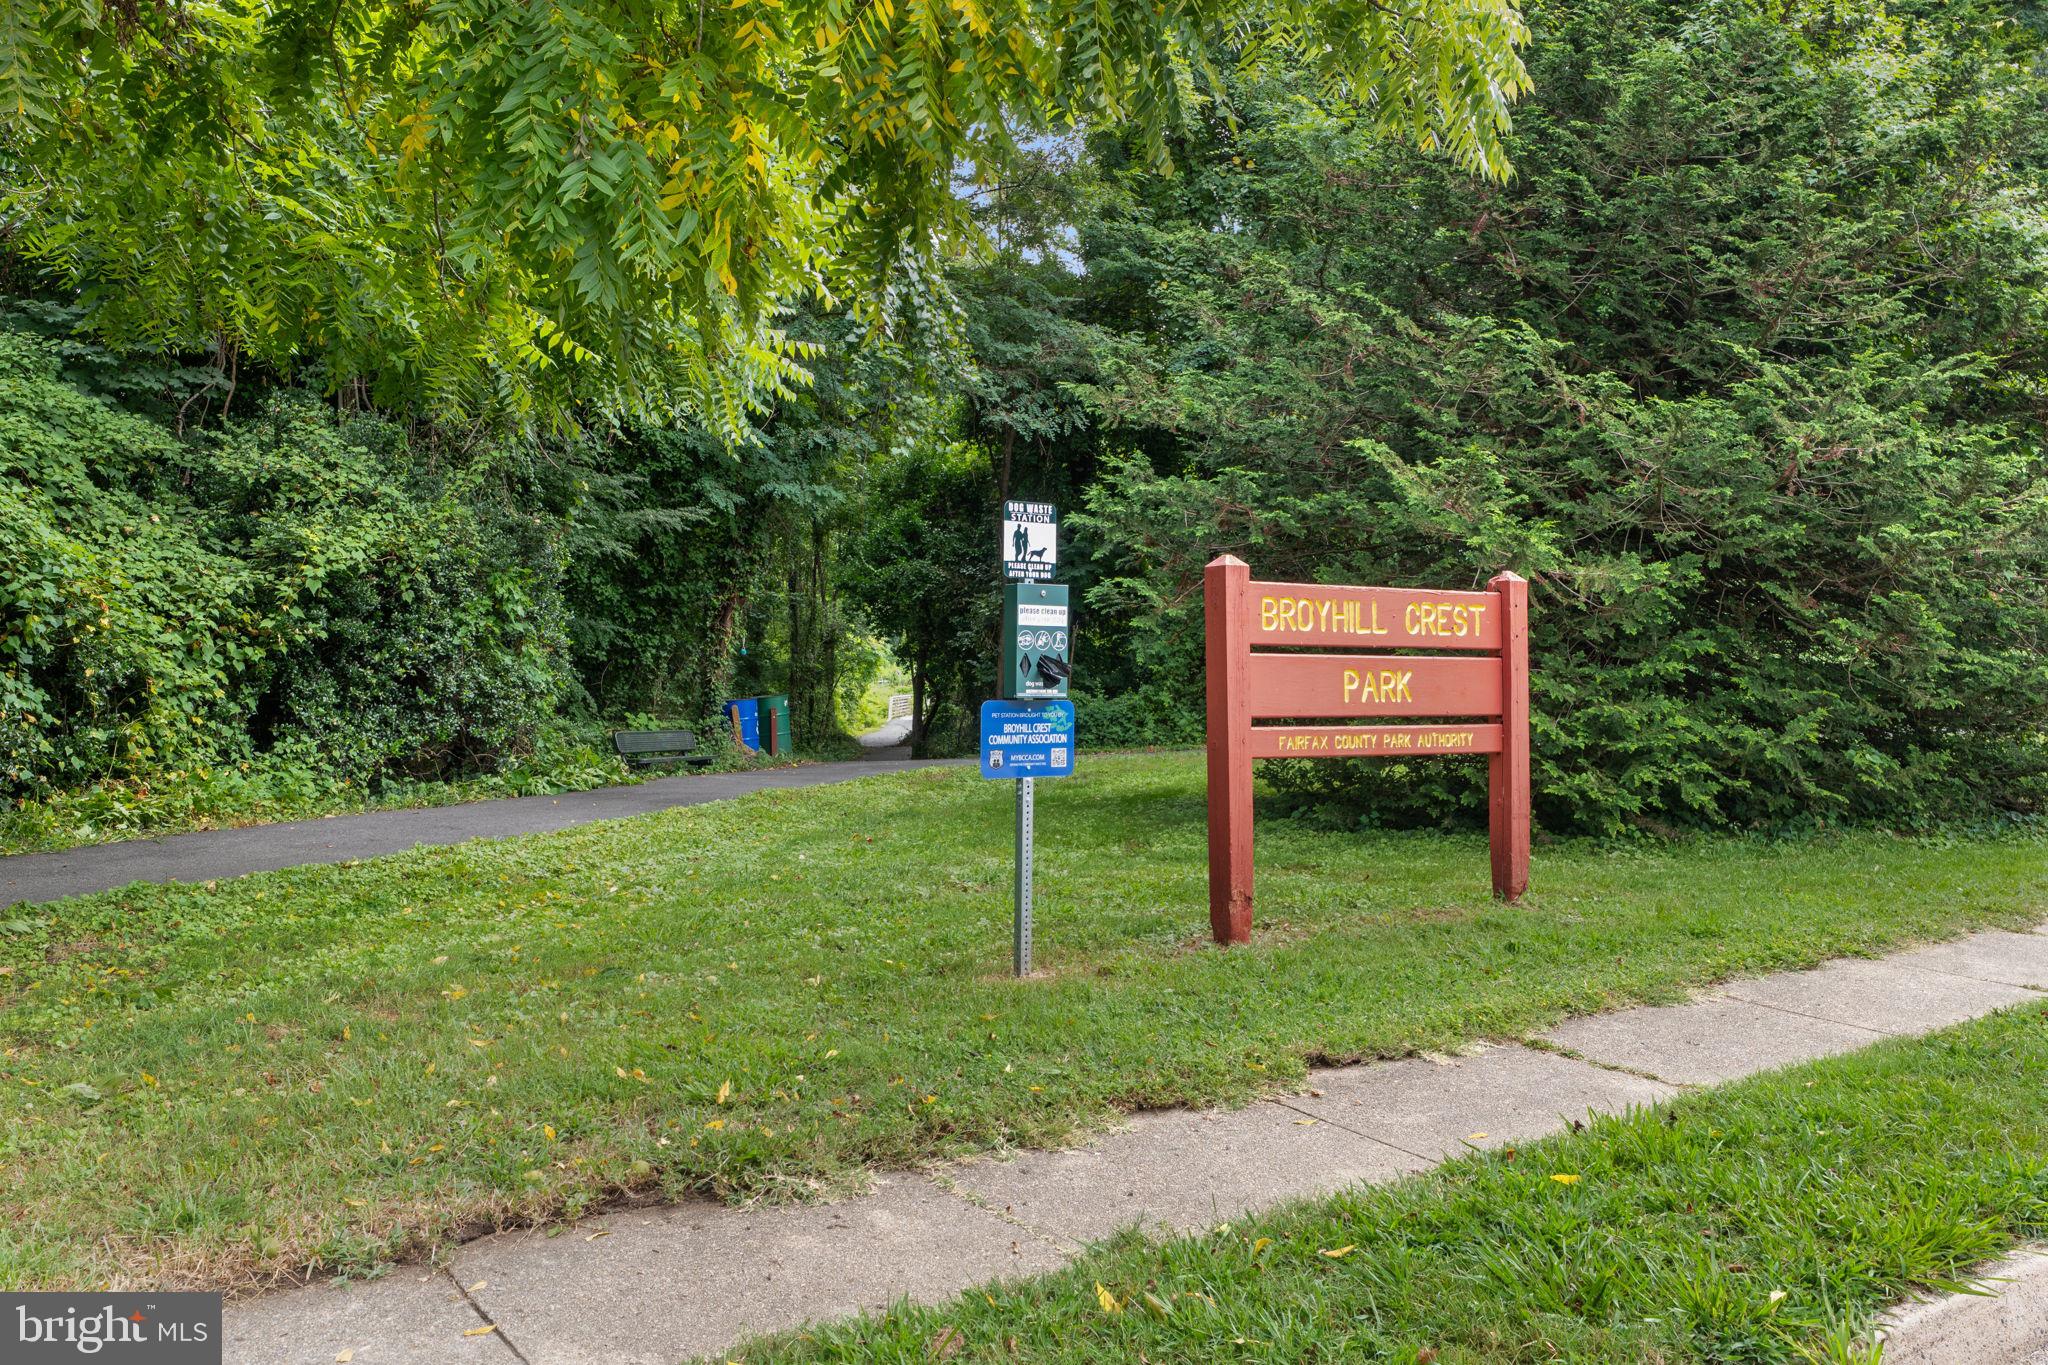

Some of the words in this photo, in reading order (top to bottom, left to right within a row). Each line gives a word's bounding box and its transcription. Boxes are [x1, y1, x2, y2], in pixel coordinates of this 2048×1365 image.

[1008, 502, 1024, 512] DOG
[1026, 504, 1052, 514] WASTE
[1011, 514, 1050, 523] STATION
[1020, 607, 1039, 615] please
[1261, 596, 1388, 635] BROYHILL
[1405, 602, 1486, 636] CREST
[1344, 670, 1412, 703] PARK
[1004, 723, 1032, 733] BROYHILL
[1033, 723, 1051, 732] CREST
[989, 734, 1027, 745] COMMUNITY
[1028, 734, 1067, 744] ASSOCIATION
[1279, 736, 1328, 750] FAIRFAX
[1334, 734, 1377, 749] COUNTY
[1384, 734, 1412, 748] PARK
[1418, 732, 1474, 748] AUTHORITY
